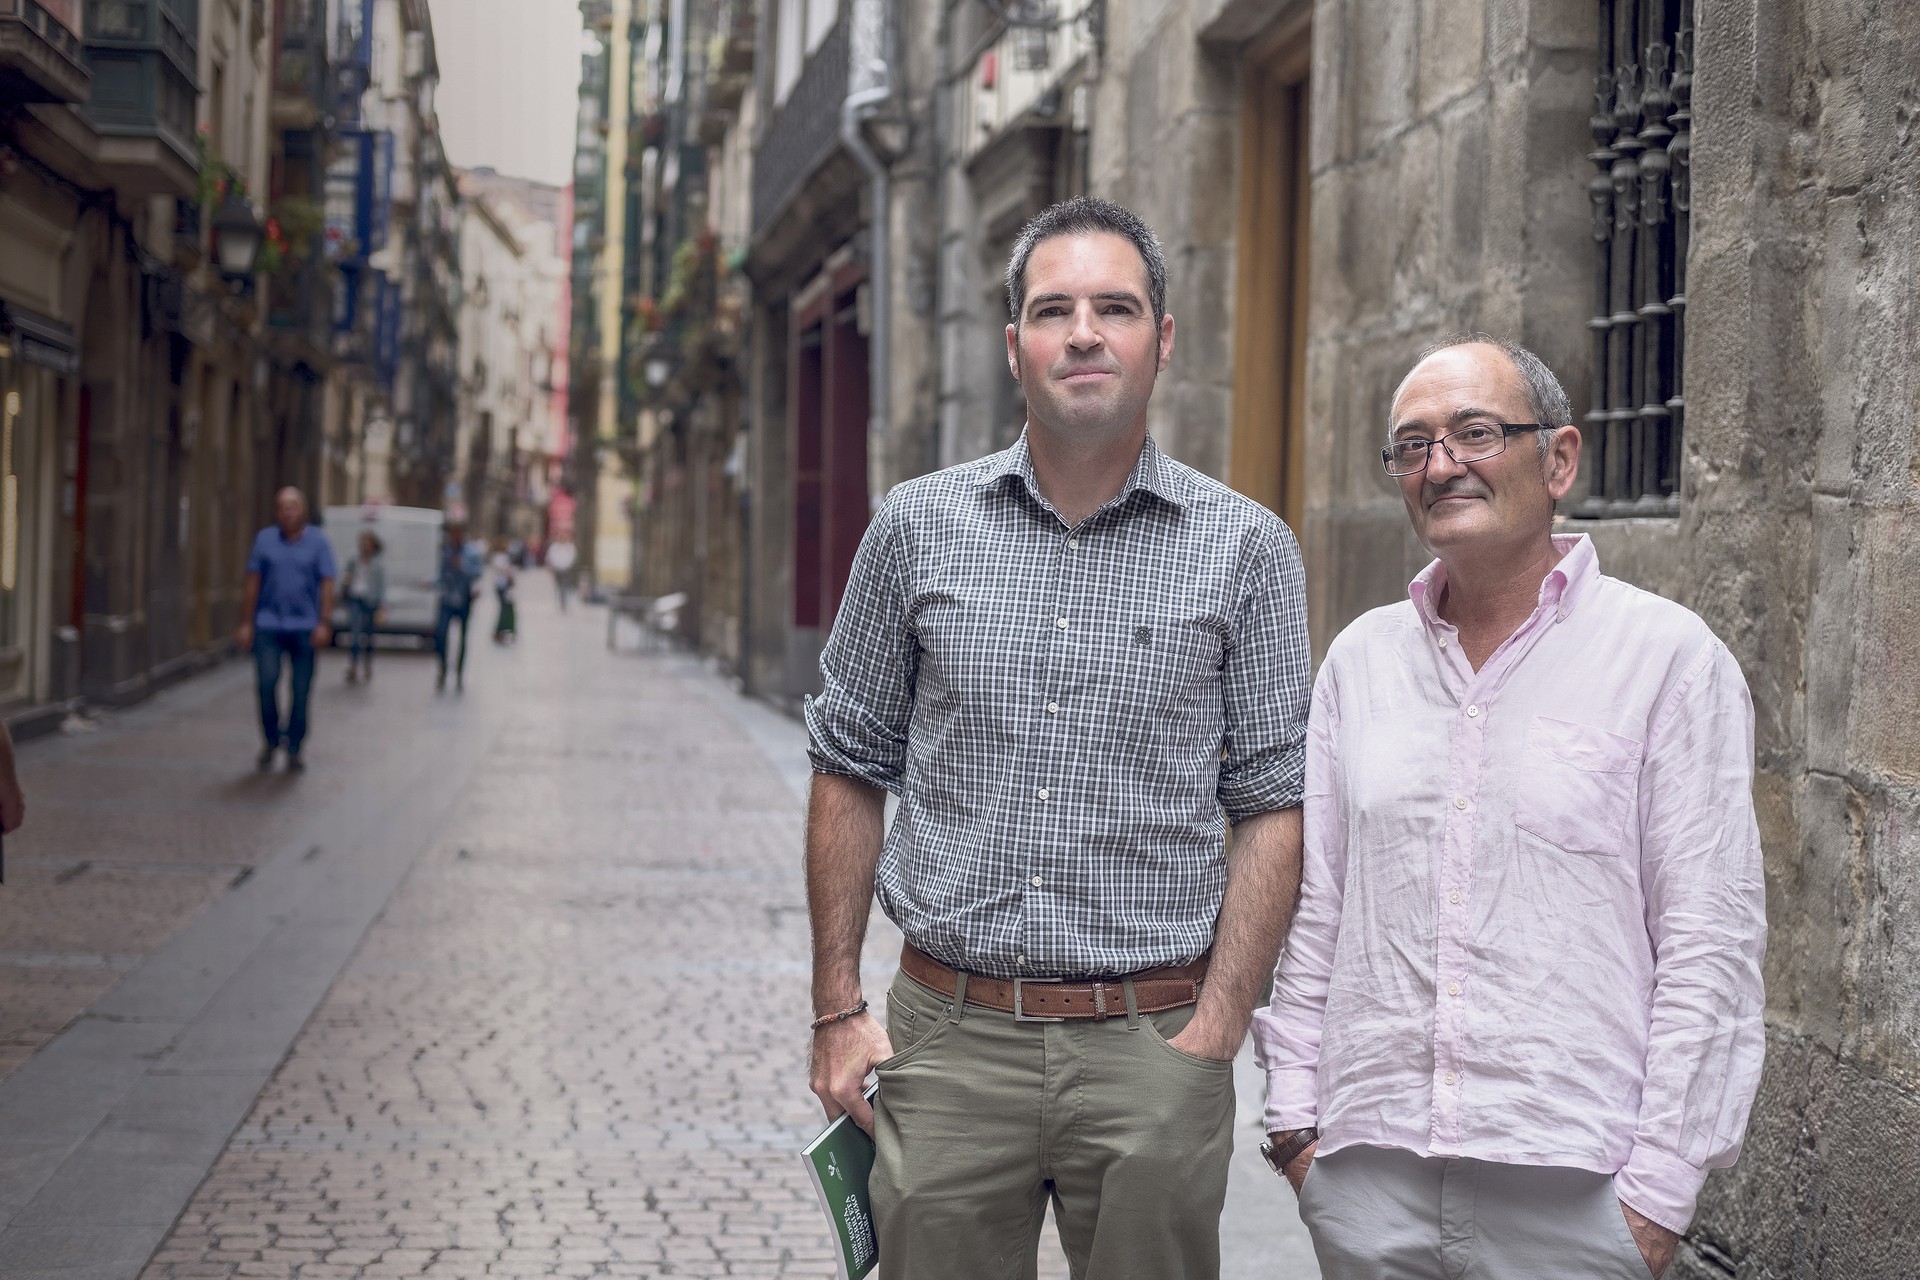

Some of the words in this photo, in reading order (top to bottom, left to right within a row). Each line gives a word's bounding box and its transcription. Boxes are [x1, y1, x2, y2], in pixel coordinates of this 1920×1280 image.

[846, 1196, 854, 1215] ETA
[850, 1194, 870, 1260] MUNGIALDEKO
[863, 1213, 874, 1256] EUSKARA
